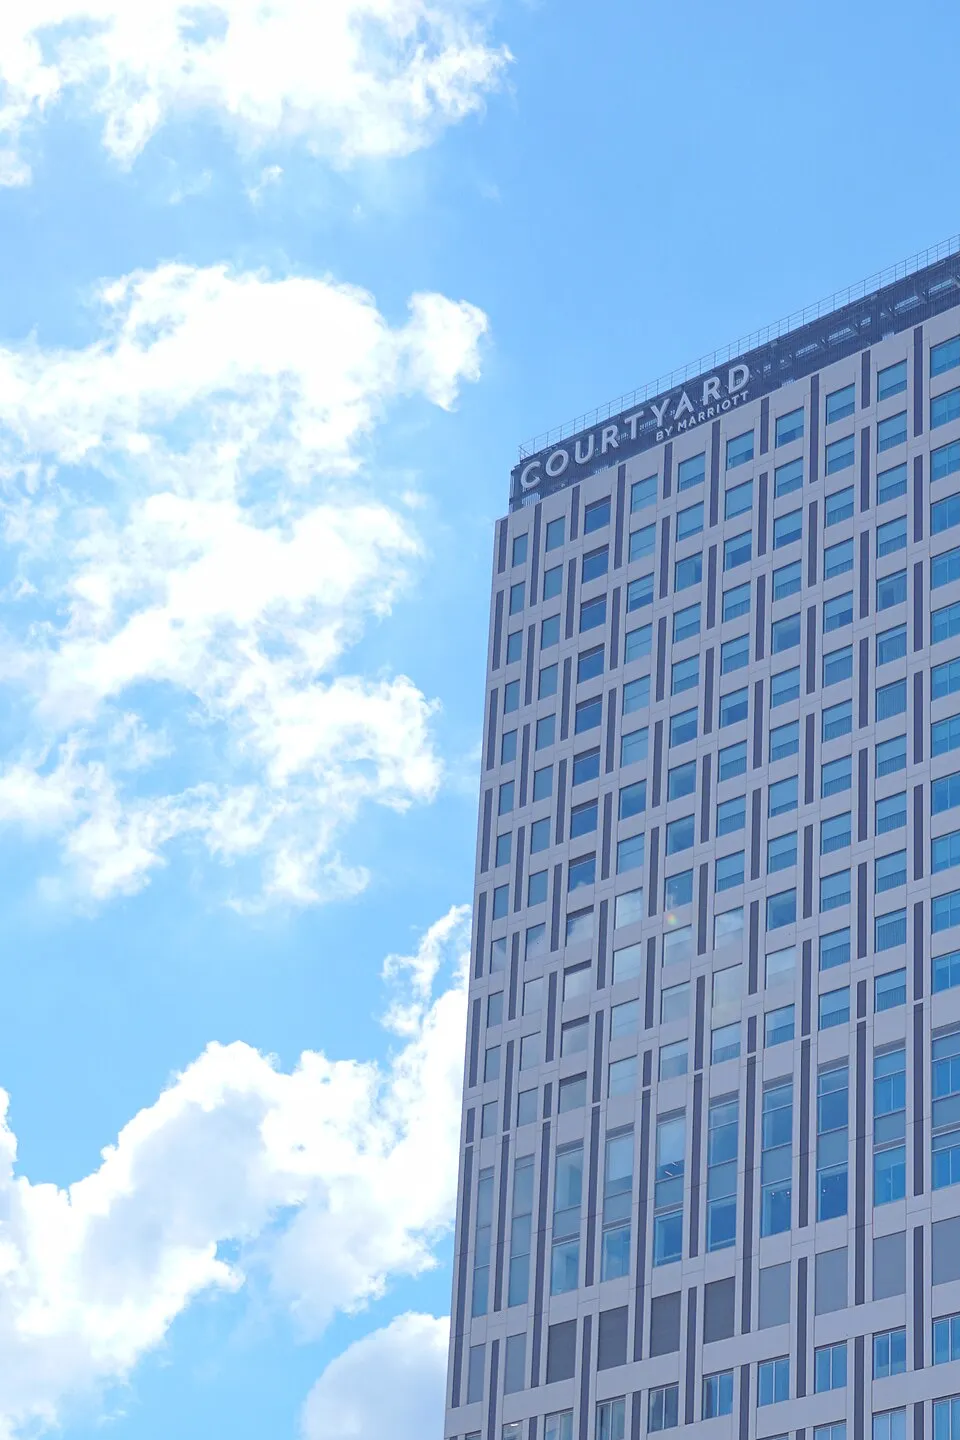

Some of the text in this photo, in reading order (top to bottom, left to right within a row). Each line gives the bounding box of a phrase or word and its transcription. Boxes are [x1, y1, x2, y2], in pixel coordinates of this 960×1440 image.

[520, 364, 750, 489] COURTYARD
[656, 390, 749, 442] BY MARRIOTT
